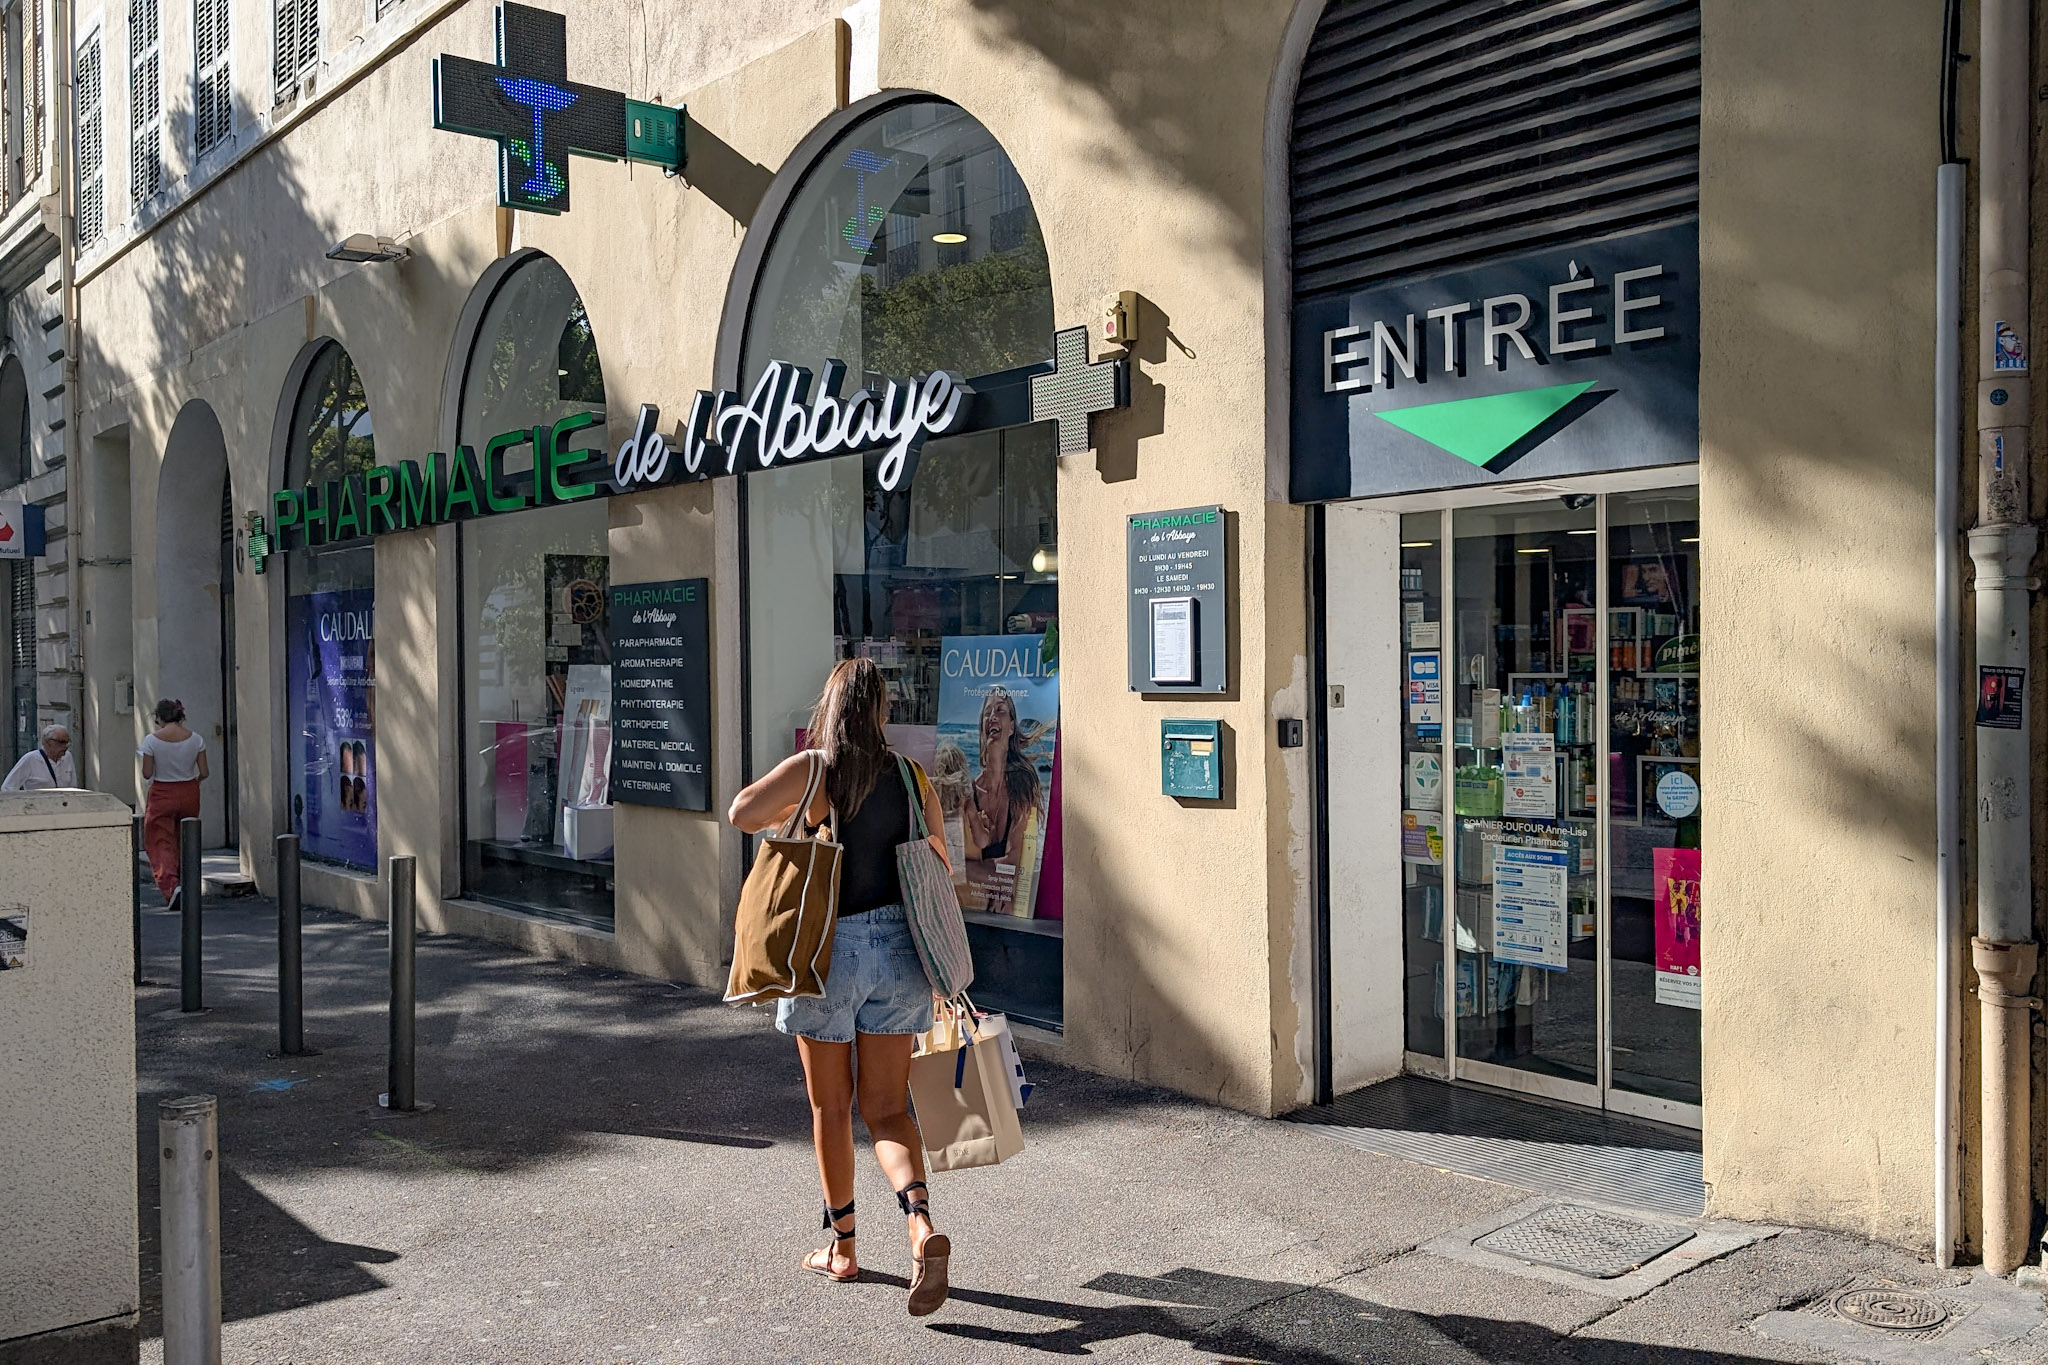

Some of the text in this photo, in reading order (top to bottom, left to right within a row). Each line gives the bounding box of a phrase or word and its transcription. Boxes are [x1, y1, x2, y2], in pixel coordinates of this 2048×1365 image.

[1323, 259, 1665, 392] ENTRÉE
[273, 359, 964, 550] PHARMACIE de l'Abbaye
[1132, 511, 1217, 531] PHARMACIE
[1150, 532, 1160, 542] de
[1148, 554, 1166, 562] LUNDI
[1178, 550, 1209, 559] VENDREDI
[1154, 564, 1169, 572] 8H30
[1175, 562, 1193, 571] 19H45
[1166, 573, 1188, 582] SAMEDI
[1134, 587, 1148, 595] 8H30
[1196, 583, 1215, 591] 19H30
[614, 586, 696, 607] PHARMACIE
[632, 607, 677, 628] de l'Abbaye
[619, 636, 683, 648] PARAPHARMACIE
[620, 657, 684, 668] AROMATHERAPIE
[620, 679, 674, 688] HOMEOPATHIE
[995, 686, 1029, 697] Rayonnez.
[620, 699, 684, 709] PHYTHOTERAPIE
[621, 719, 669, 730] ORTHOPEDIE
[621, 739, 695, 752] MATERIEL MEDICAL
[621, 759, 702, 774] MAINTIEN A DOMICILE
[1670, 774, 1683, 785] ici
[622, 780, 672, 793] VETERINAIRE
[1546, 825, 1588, 837] Anne-Lise
[1480, 831, 1511, 842] Docteur
[1525, 835, 1569, 848] Pharmacie
[1659, 977, 1682, 985] RÉSERVEZ
